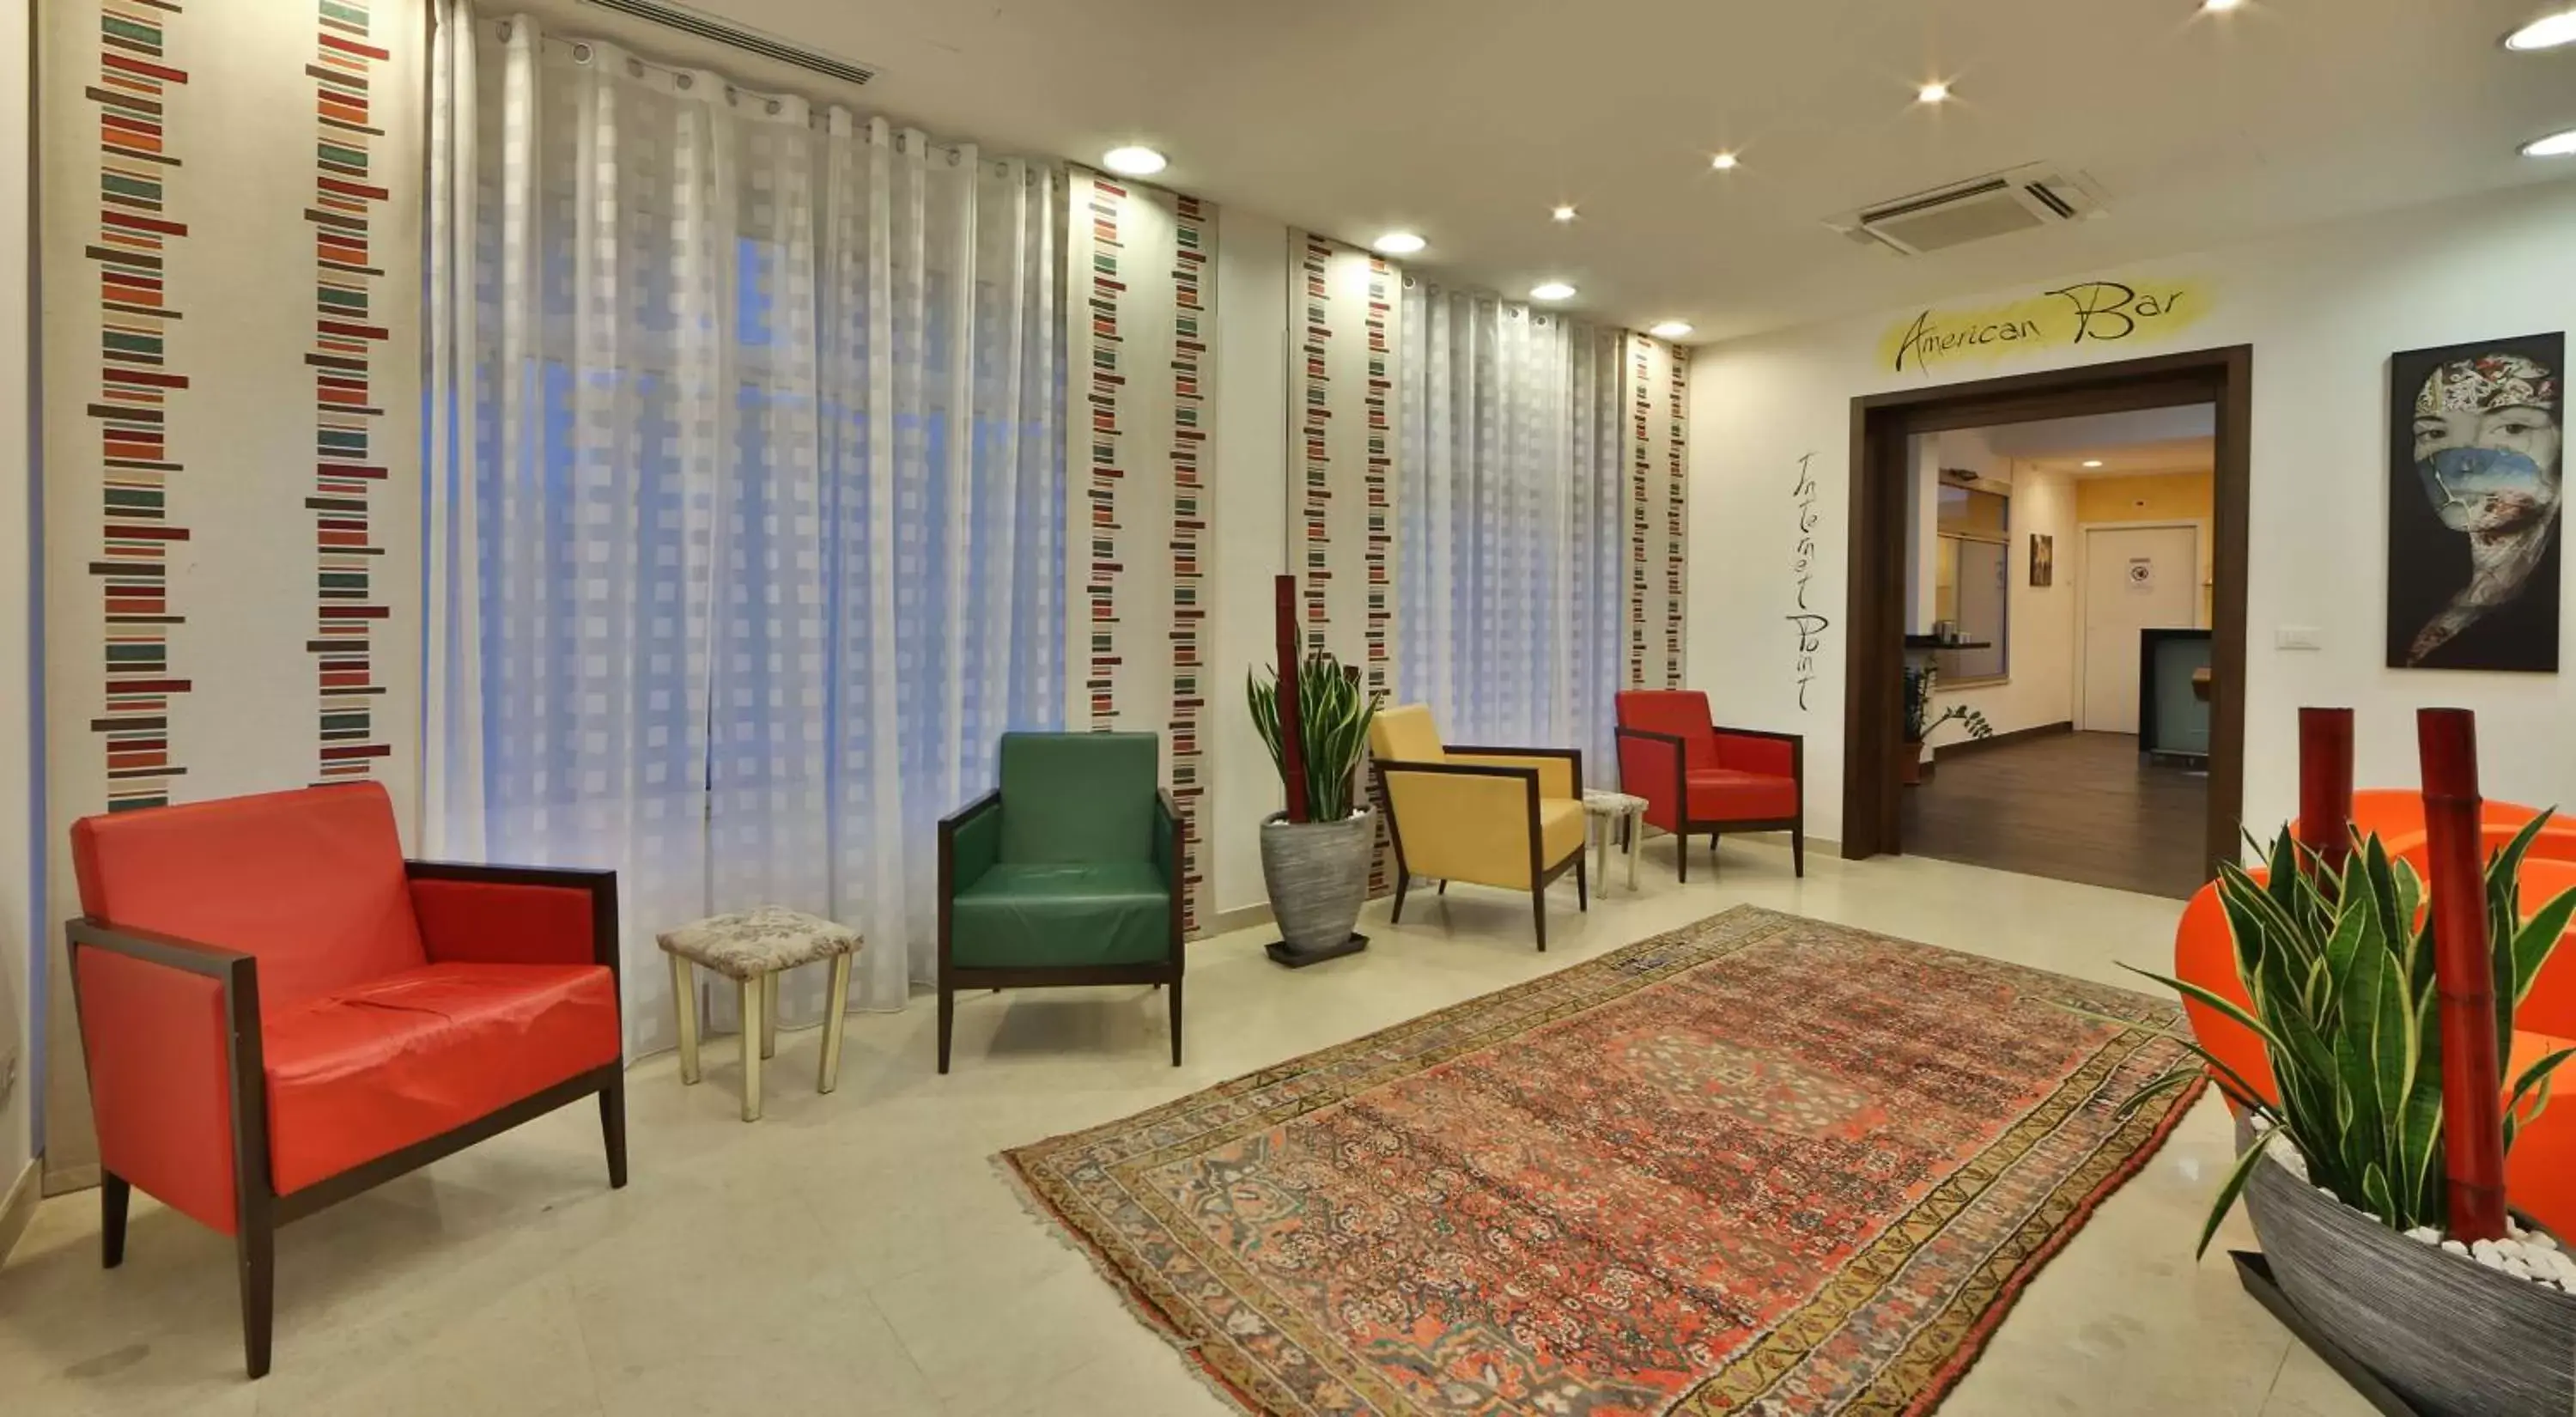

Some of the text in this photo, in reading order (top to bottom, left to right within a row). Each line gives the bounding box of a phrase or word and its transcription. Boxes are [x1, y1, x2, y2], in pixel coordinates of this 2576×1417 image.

[1894, 281, 2184, 378] American Bar
[1784, 451, 1830, 712] Internet Point
